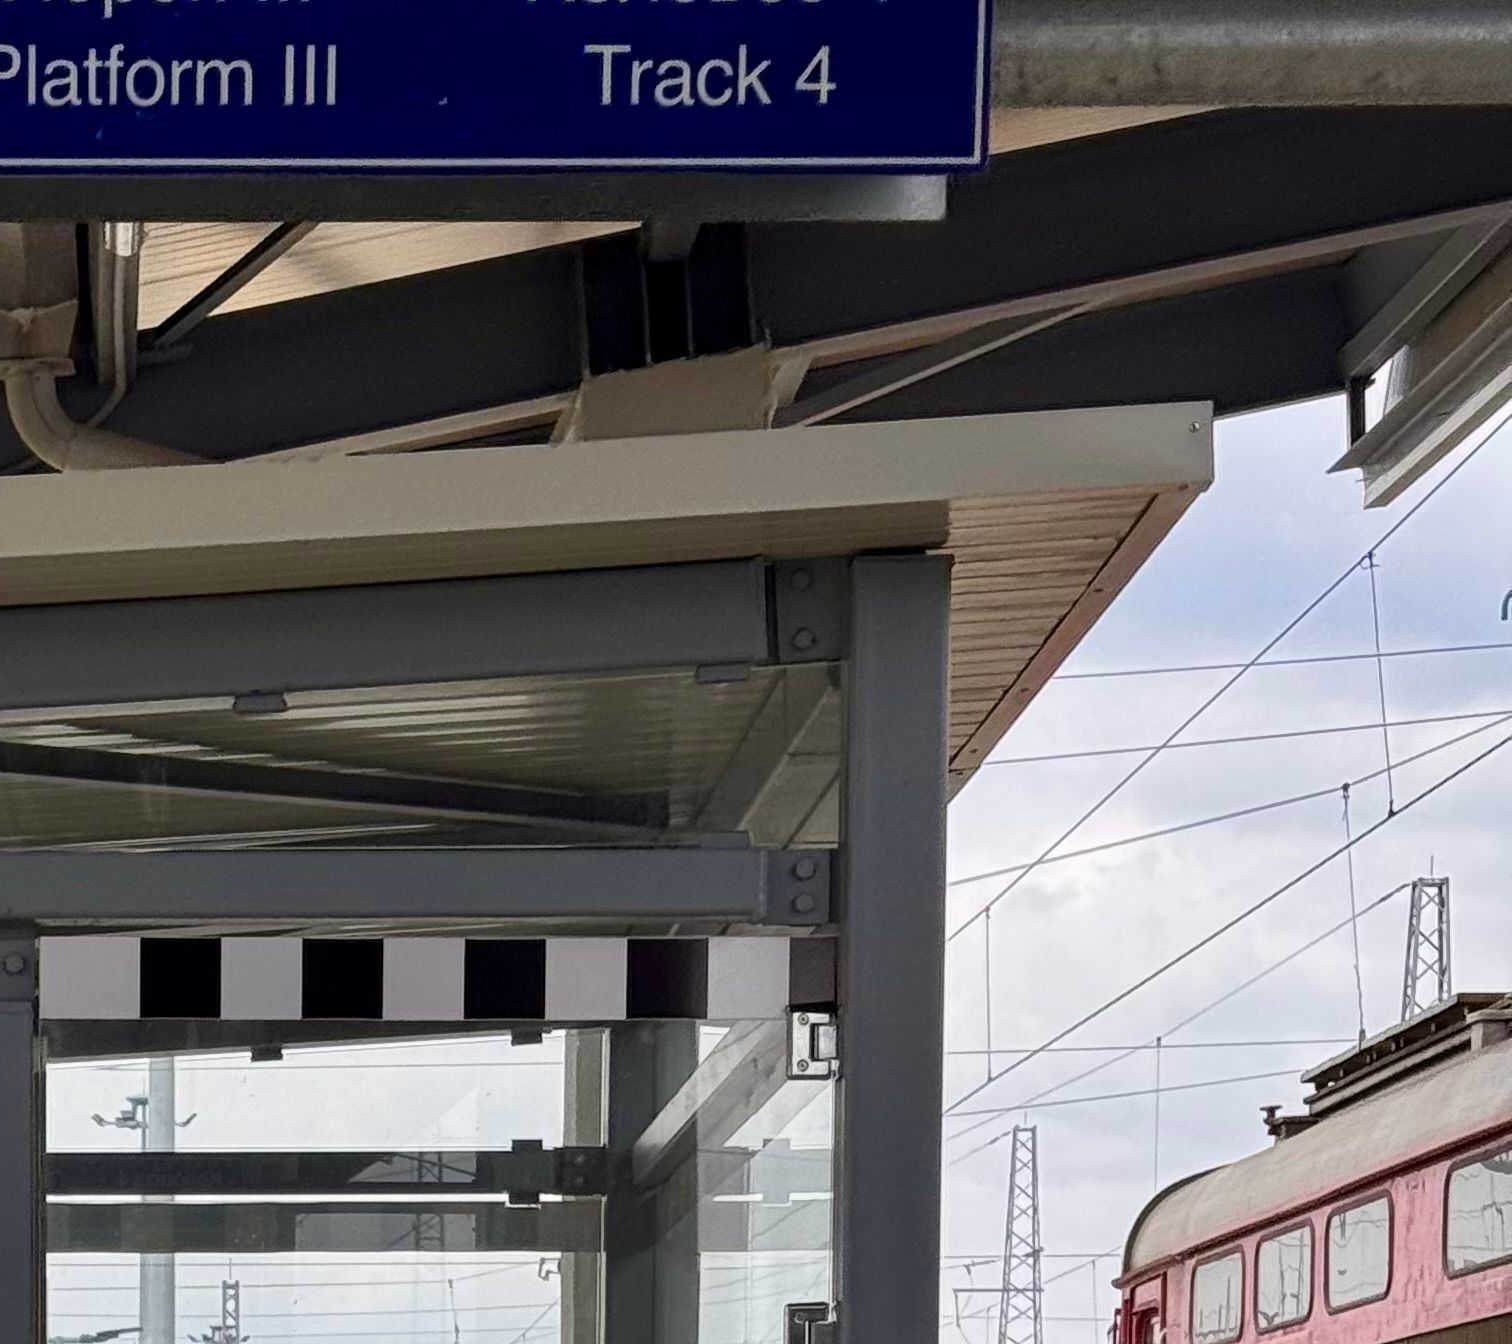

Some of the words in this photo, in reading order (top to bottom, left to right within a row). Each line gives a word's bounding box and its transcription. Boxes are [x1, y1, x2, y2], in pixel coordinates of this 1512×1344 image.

[283, 43, 338, 107] III
[583, 43, 772, 107] Track
[794, 44, 837, 105] 4
